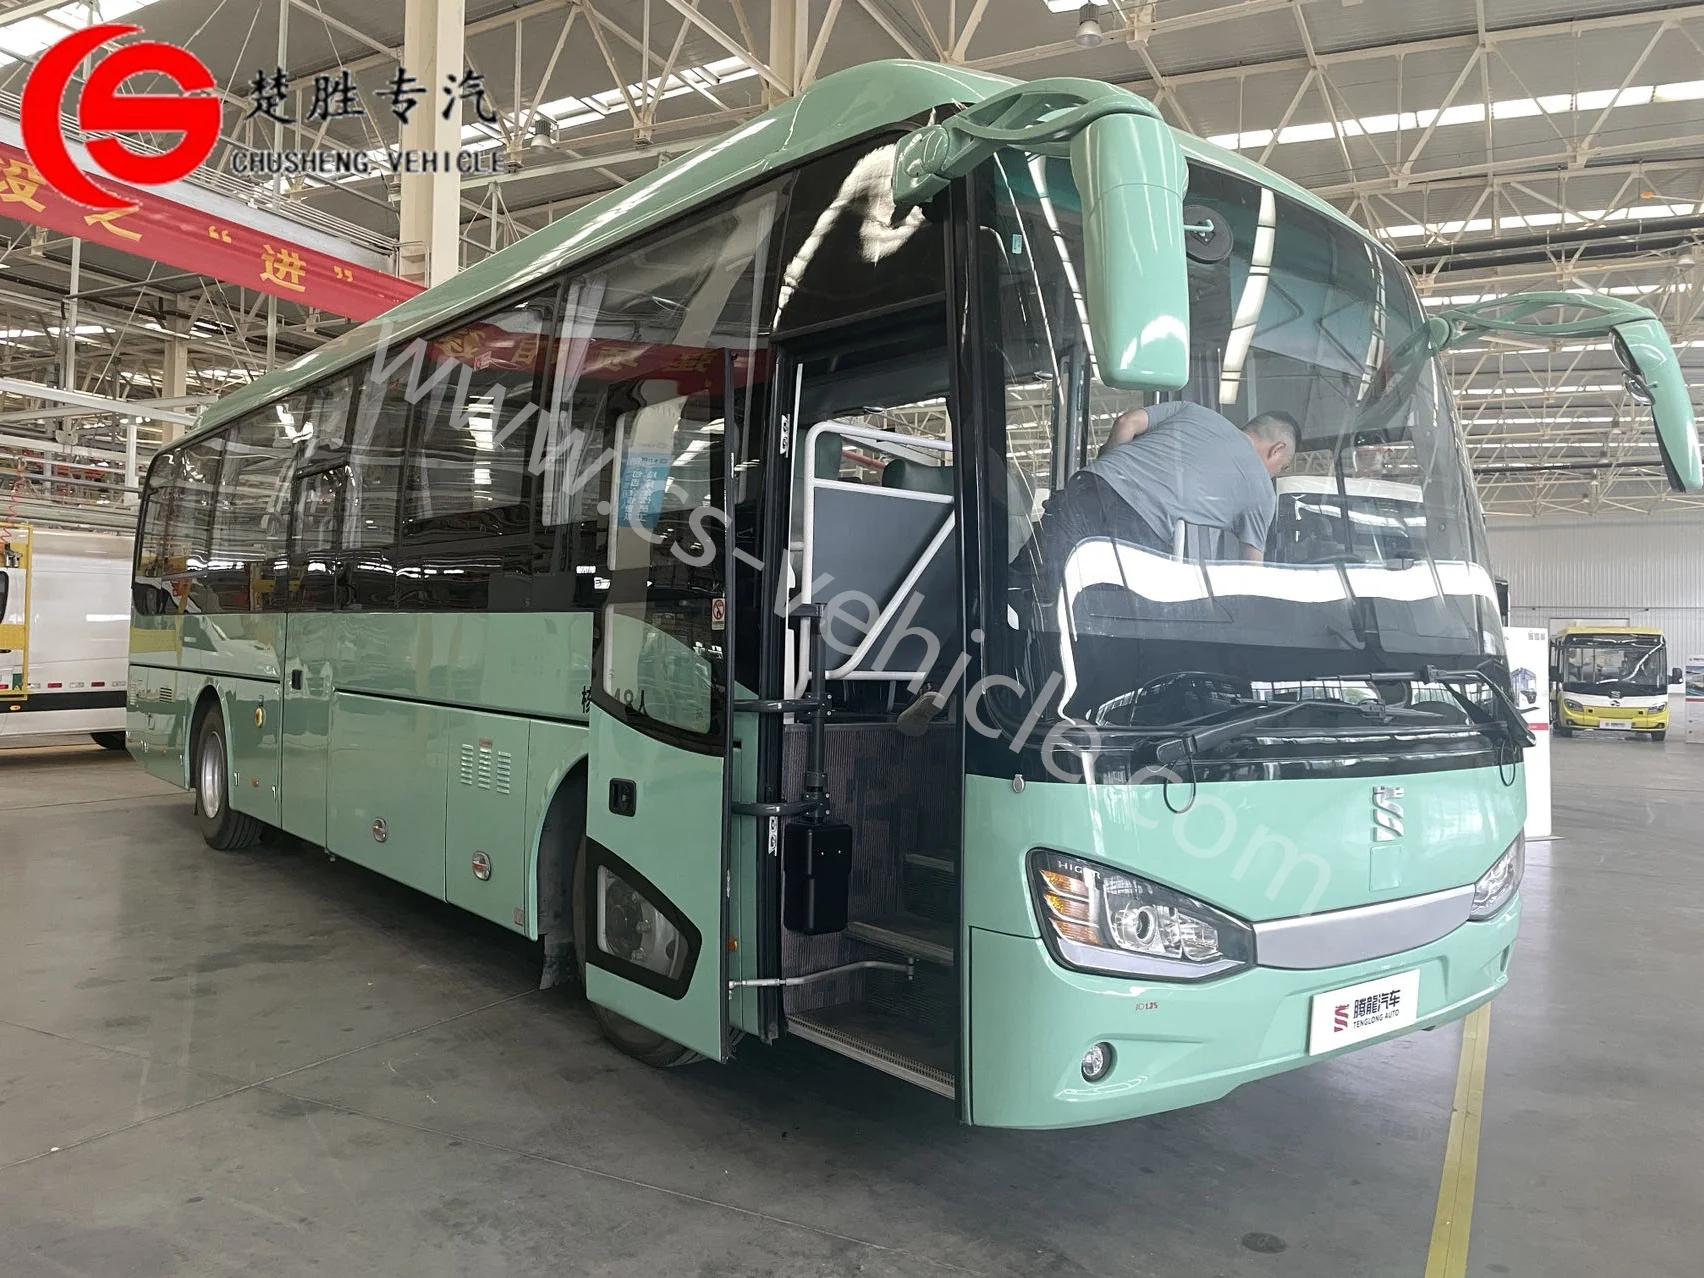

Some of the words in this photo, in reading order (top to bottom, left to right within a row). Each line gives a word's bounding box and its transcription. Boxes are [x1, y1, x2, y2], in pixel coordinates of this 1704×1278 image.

[1058, 860, 1101, 879] HIGR
[1353, 1014, 1384, 1029] TENGLONG
[1384, 1009, 1400, 1020] AUTO
